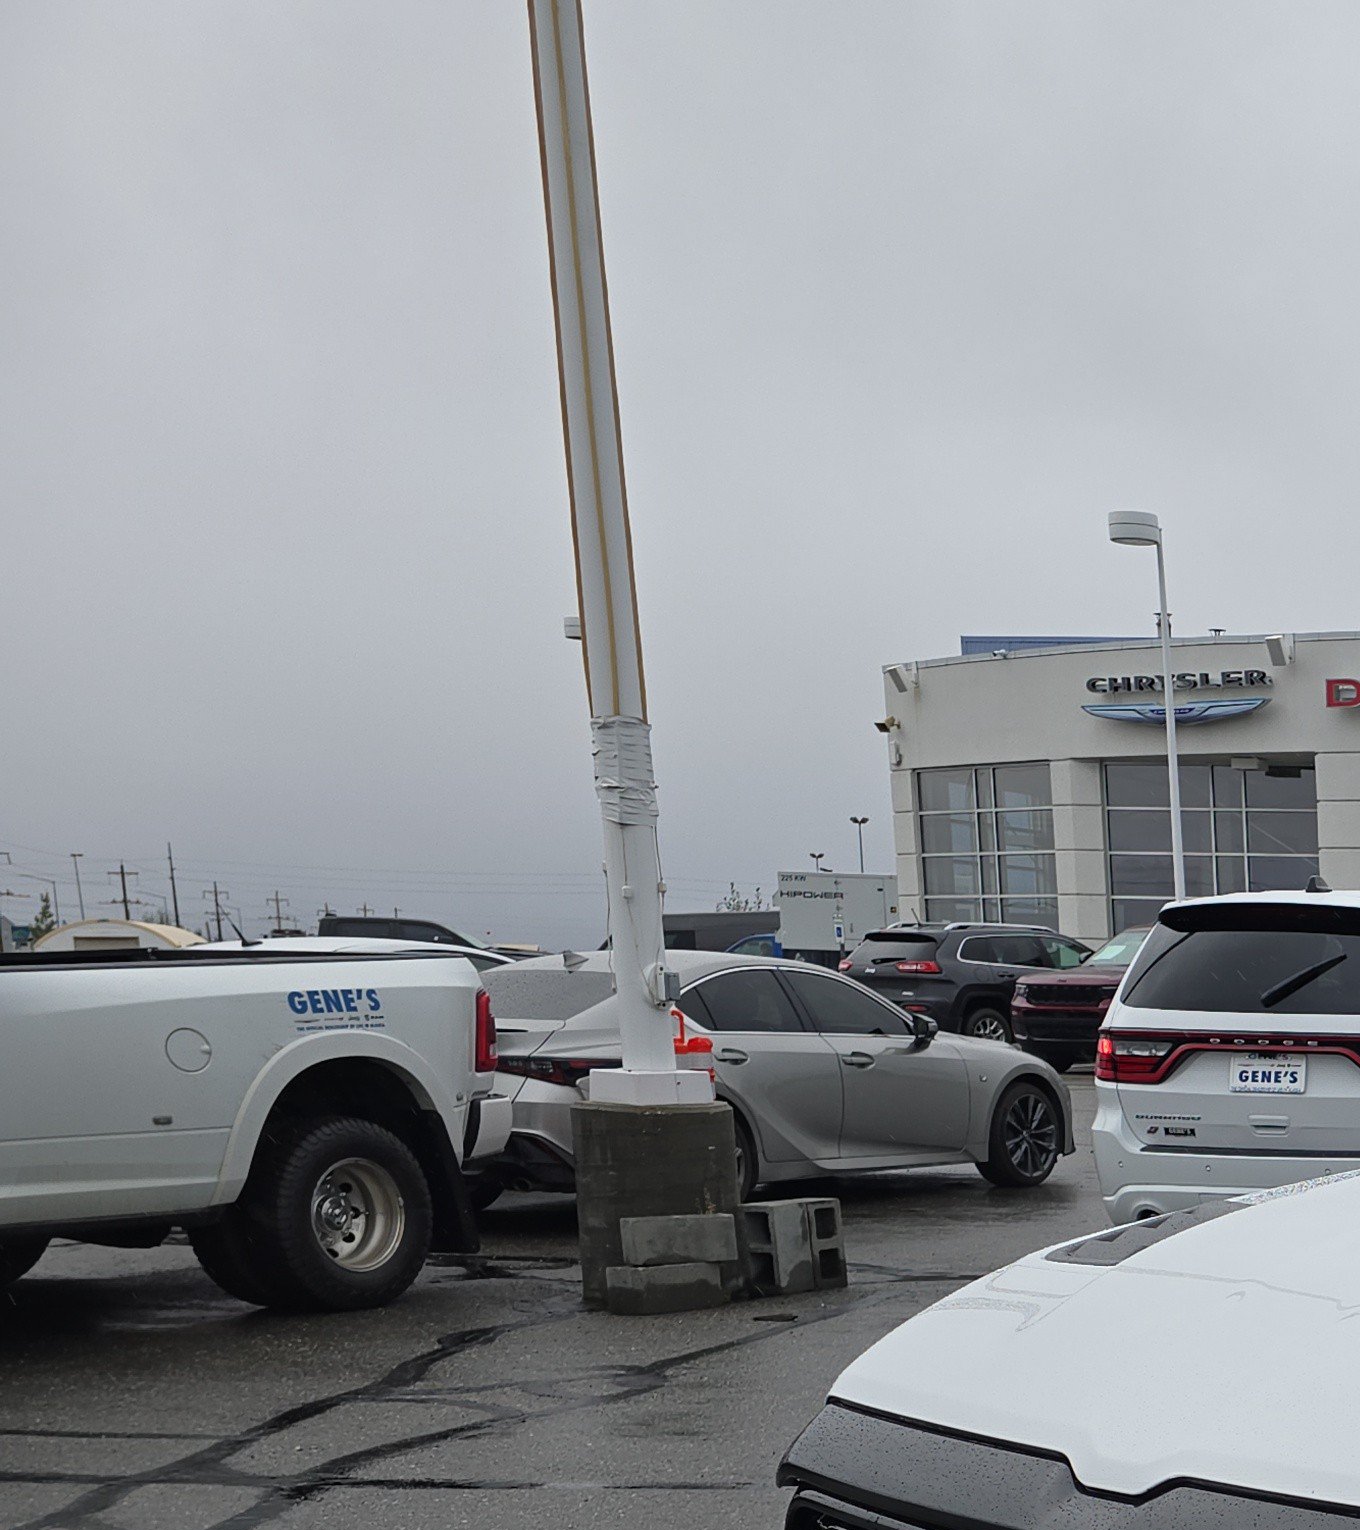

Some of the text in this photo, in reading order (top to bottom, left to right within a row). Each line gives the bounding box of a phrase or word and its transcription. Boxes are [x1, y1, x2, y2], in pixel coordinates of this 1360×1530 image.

[780, 890, 844, 899] HIPOWER
[287, 989, 381, 1014] GENE'S
[1238, 1070, 1299, 1083] GENE'S
